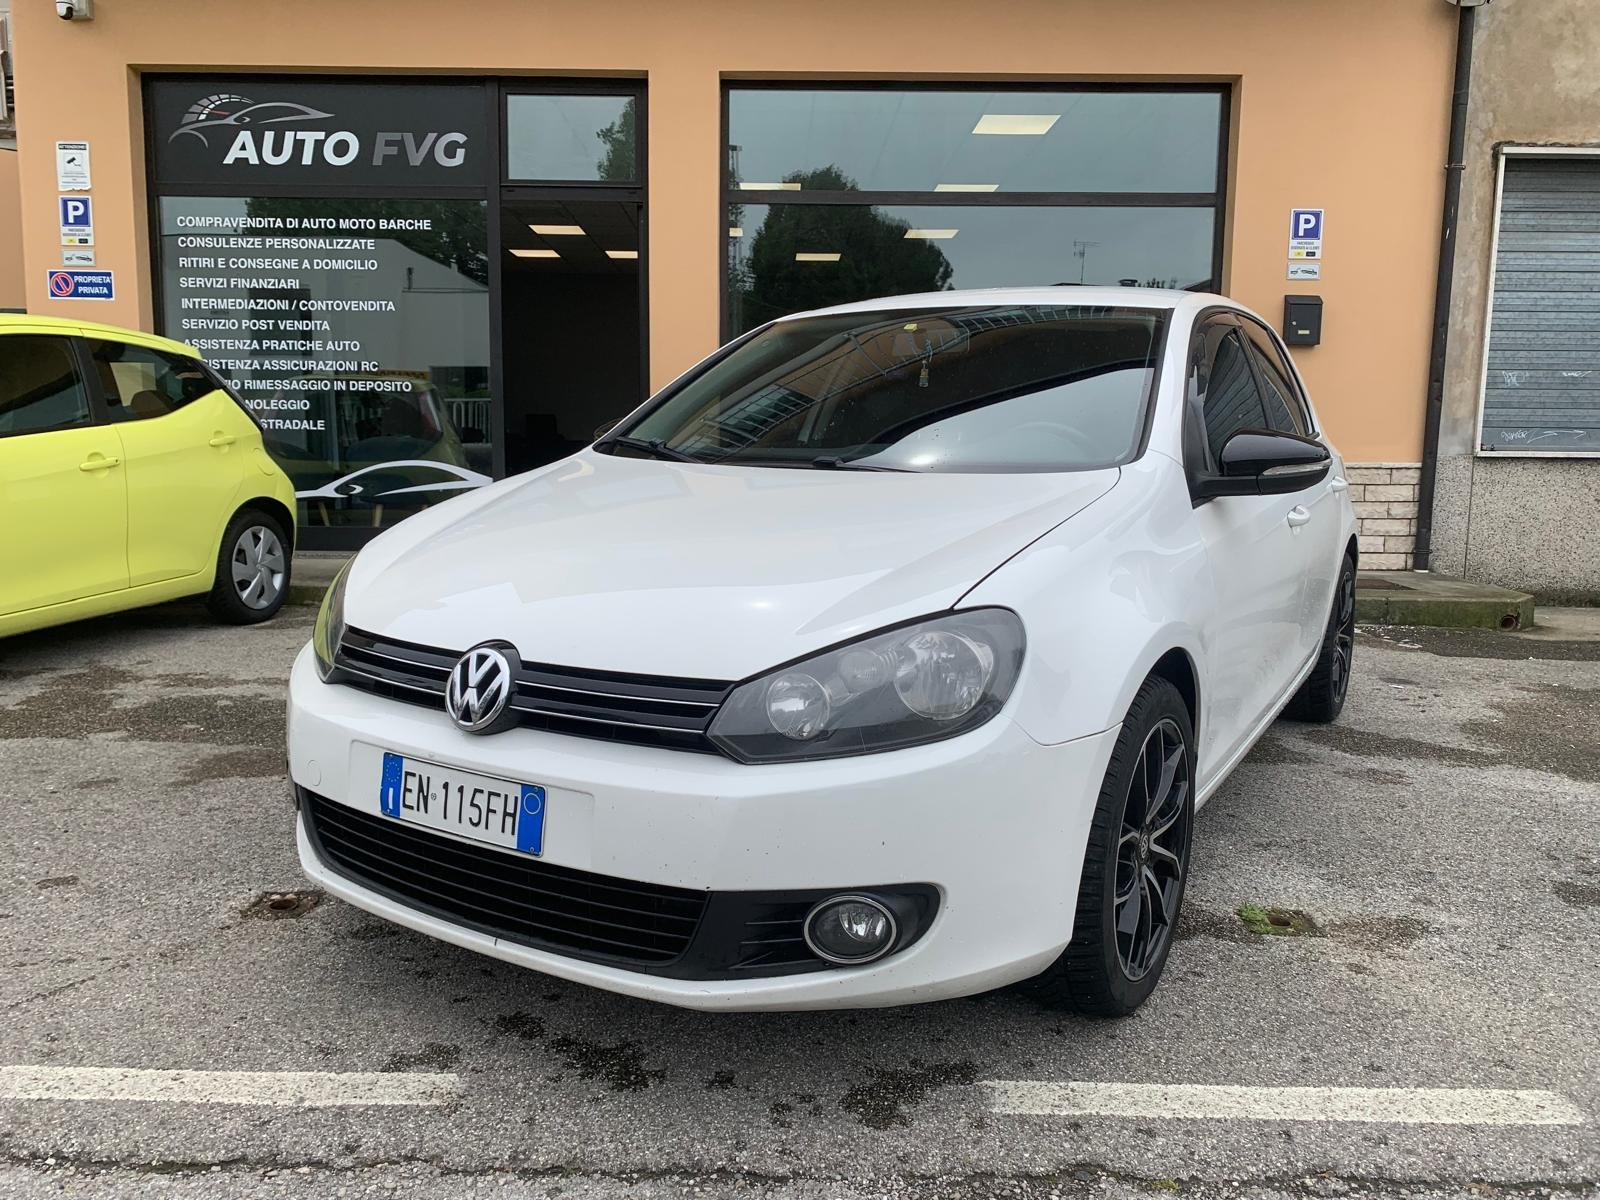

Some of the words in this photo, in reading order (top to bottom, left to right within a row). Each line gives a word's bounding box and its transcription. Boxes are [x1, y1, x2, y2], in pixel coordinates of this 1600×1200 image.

[222, 130, 360, 166] AUTO
[371, 132, 468, 167] FVG
[67, 200, 85, 224] P
[176, 216, 283, 229] COMPRAVENDITA
[286, 217, 299, 229] DI
[301, 218, 336, 230] AUTO
[339, 218, 376, 230] MOTO
[379, 218, 432, 230] BARCHE
[1298, 213, 1316, 237] P
[177, 236, 262, 249] CONSULENZE
[265, 238, 376, 250] PERSONALIZZATE
[178, 257, 215, 269] RITIRI
[217, 257, 226, 269] E
[228, 257, 299, 270] CONSEGNE
[301, 259, 311, 270] A
[313, 259, 378, 271] DOMICILIO
[179, 276, 227, 289] SERVIZI
[230, 277, 300, 290] FINANZIARI
[78, 286, 109, 295] PRIVATA
[181, 298, 289, 310] INTERMEDIAZIONI
[291, 299, 297, 311] /
[299, 300, 396, 312] CONTOVENDITA
[181, 318, 239, 330] SERVIZIO
[241, 319, 275, 331] POST
[277, 320, 331, 331] VENDITA
[184, 339, 260, 350] ASSISTENZA
[262, 339, 323, 351] PRATICHE
[325, 340, 360, 352] AUTO
[262, 359, 358, 371] ASSICURAZIONI
[361, 360, 379, 372] RC
[244, 379, 331, 391] RIMESSAGGIO
[333, 380, 346, 391] IN
[349, 380, 412, 393] DEPOSITO
[245, 399, 310, 411] NOLEGGIO
[260, 418, 325, 431] STRADALE
[402, 770, 431, 815] EN
[442, 781, 519, 836] 115FH
